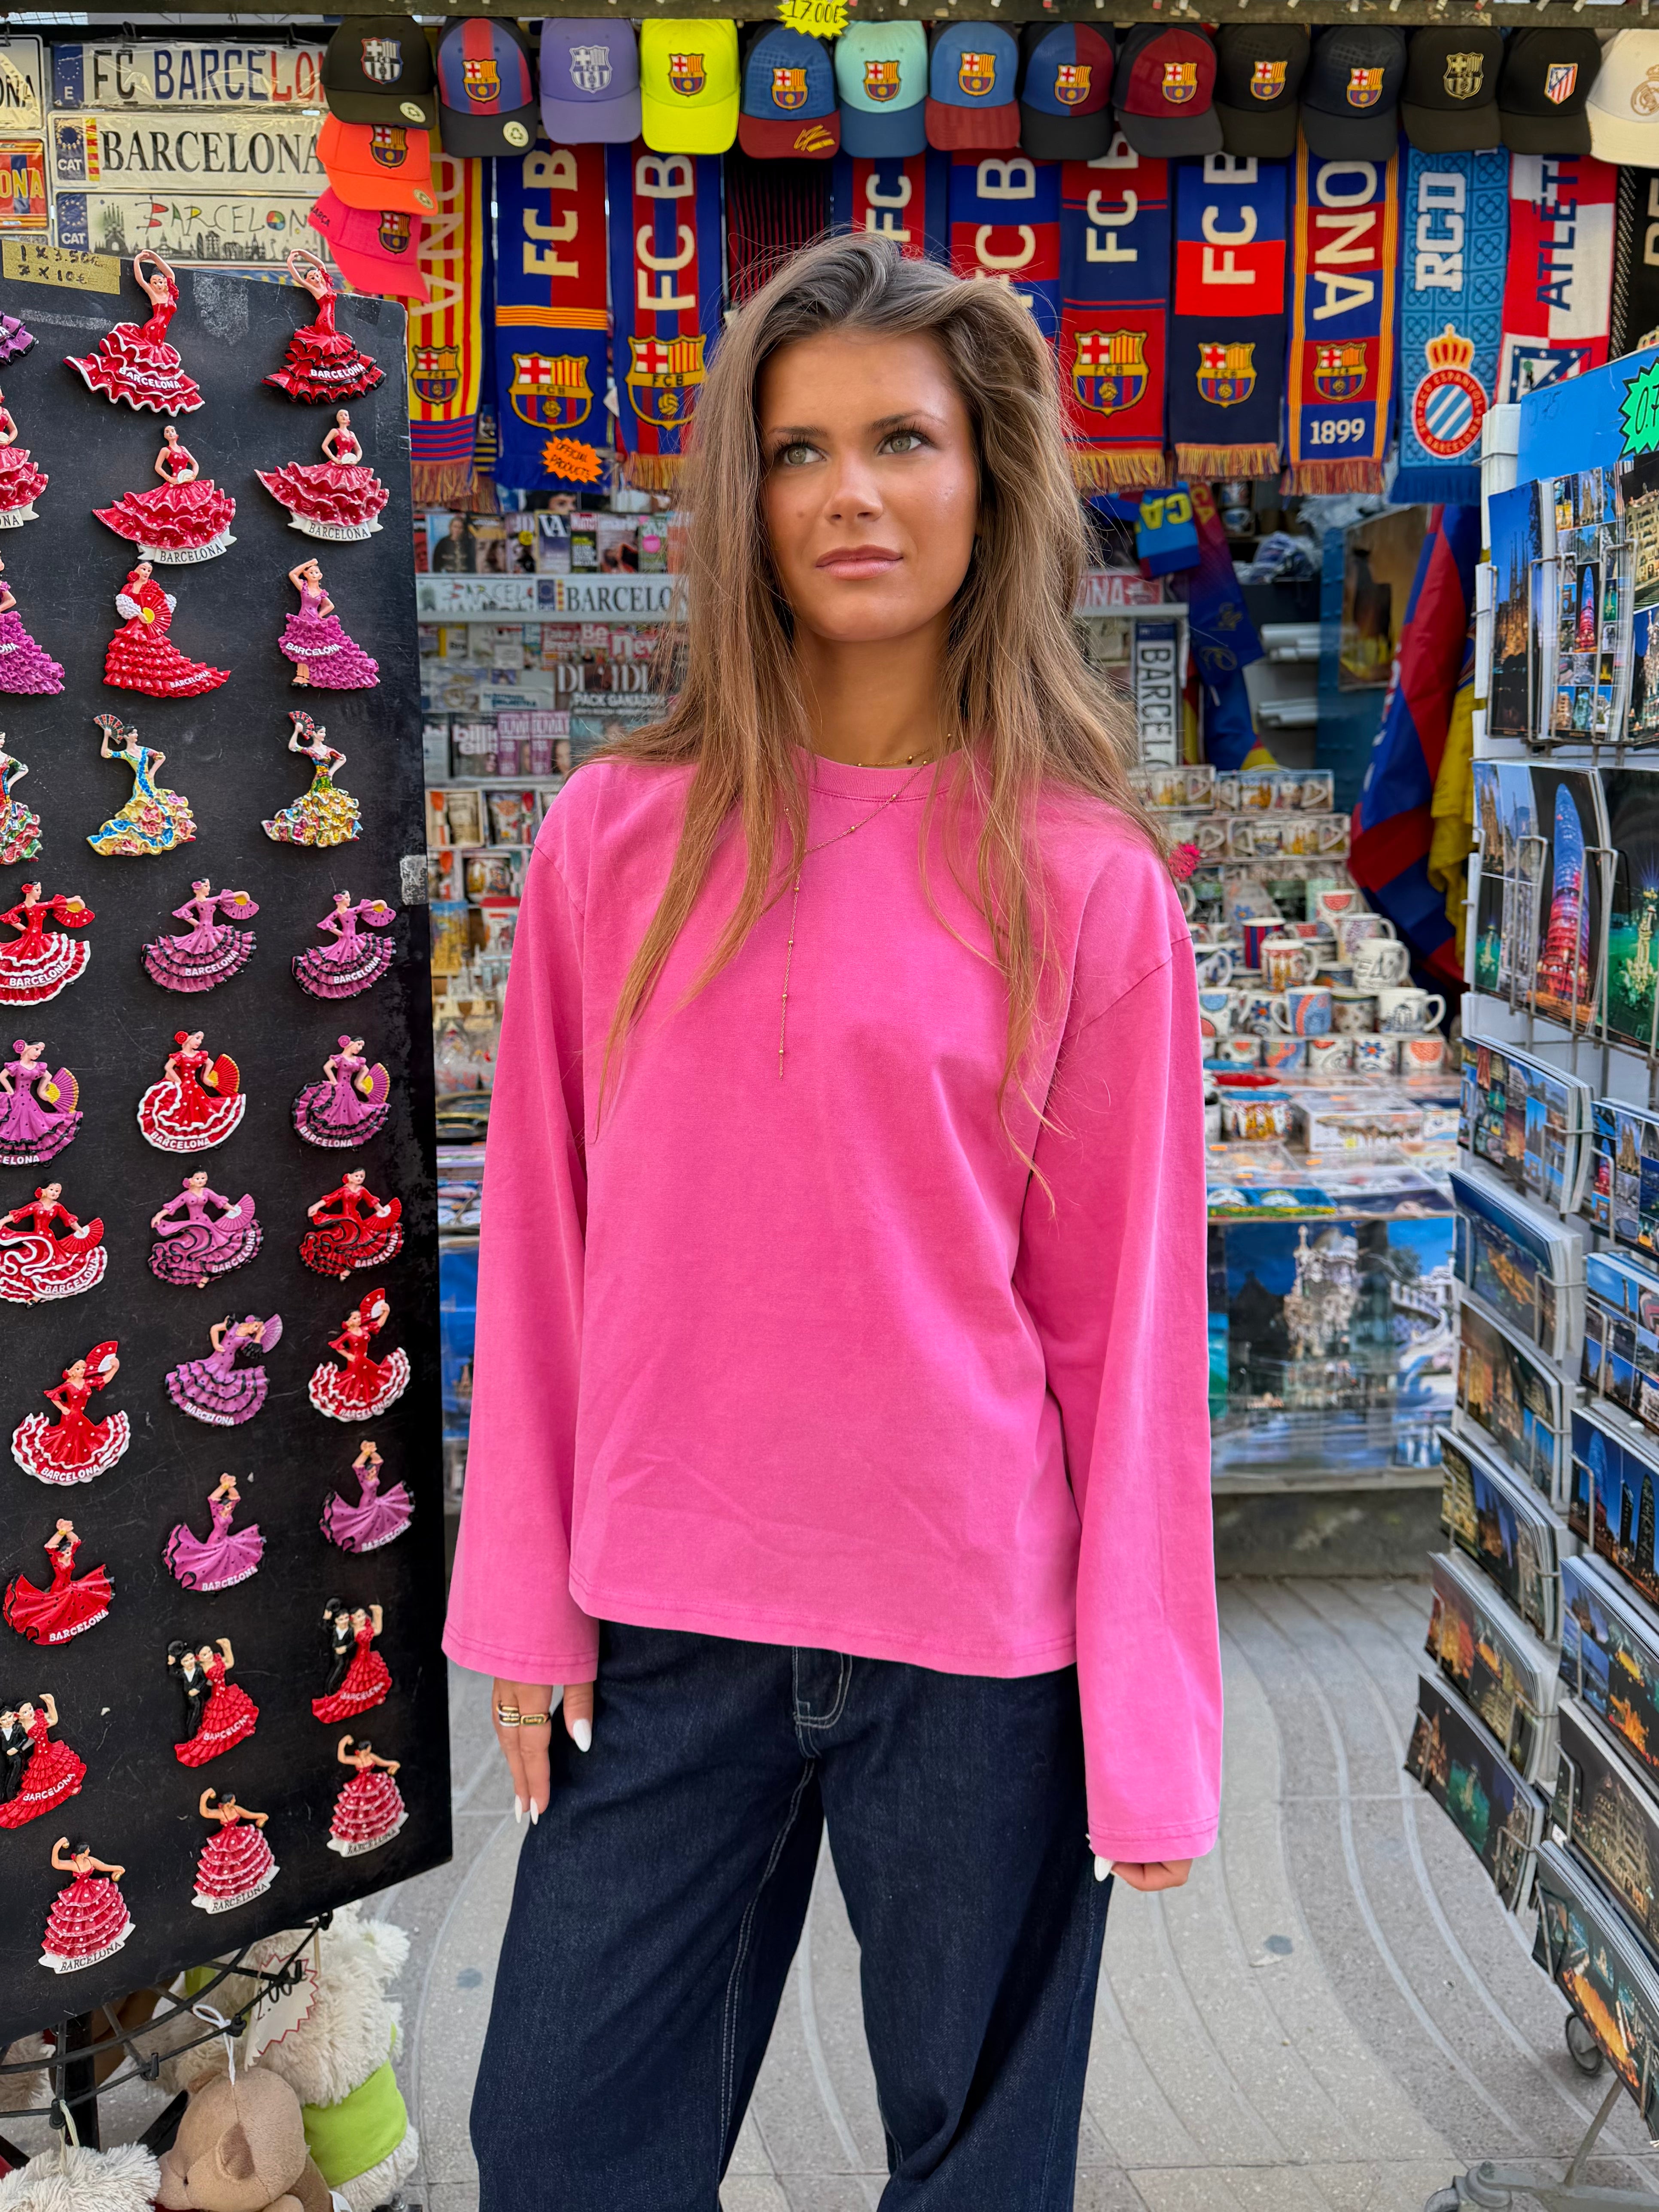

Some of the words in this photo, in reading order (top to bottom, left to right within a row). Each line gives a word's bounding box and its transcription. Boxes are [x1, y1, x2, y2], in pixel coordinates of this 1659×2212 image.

[94, 49, 135, 100] FC
[154, 48, 325, 103] BARCELO
[64, 86, 73, 100] E
[100, 130, 325, 173] BARCELONA
[58, 158, 82, 171] CAT
[1086, 189, 1138, 262] FC
[1414, 172, 1467, 292] RCD
[61, 233, 86, 244] CAT
[523, 208, 579, 279] FC
[1202, 205, 1258, 285] FC
[635, 224, 697, 311] FC
[119, 367, 181, 390] BARCELONA
[310, 363, 365, 379] BARCELONA
[652, 373, 684, 387] FCB
[1094, 365, 1124, 376] FCB
[536, 385, 566, 396] FCB
[1310, 418, 1365, 445] 1899
[0, 514, 20, 526] NA
[308, 524, 369, 539] BARCELONA
[160, 542, 222, 563] BARCELONA
[285, 642, 343, 656] BARCELONA
[170, 670, 211, 689] BARCELONA
[9, 960, 69, 987] BARCELONA
[185, 950, 239, 976] BARCELONA
[333, 955, 382, 984] BARCELONA
[149, 1131, 210, 1148] BARCELONA
[299, 1126, 353, 1148] BARCELONA
[0, 1155, 40, 1165] ELONA
[212, 1229, 257, 1273] BARCELONA
[354, 1232, 400, 1268] BARCELONA
[45, 1256, 98, 1293] BARCELONA
[185, 1401, 234, 1426] BARCELONA
[41, 1465, 101, 1483] BARCELONA
[201, 1566, 259, 1591] BARCELONA
[49, 1610, 109, 1642] BARCELONA
[23, 1772, 76, 1802] BARCELONA
[212, 1881, 268, 1913] BARCELONA
[59, 1940, 121, 1973] BARCELONA
